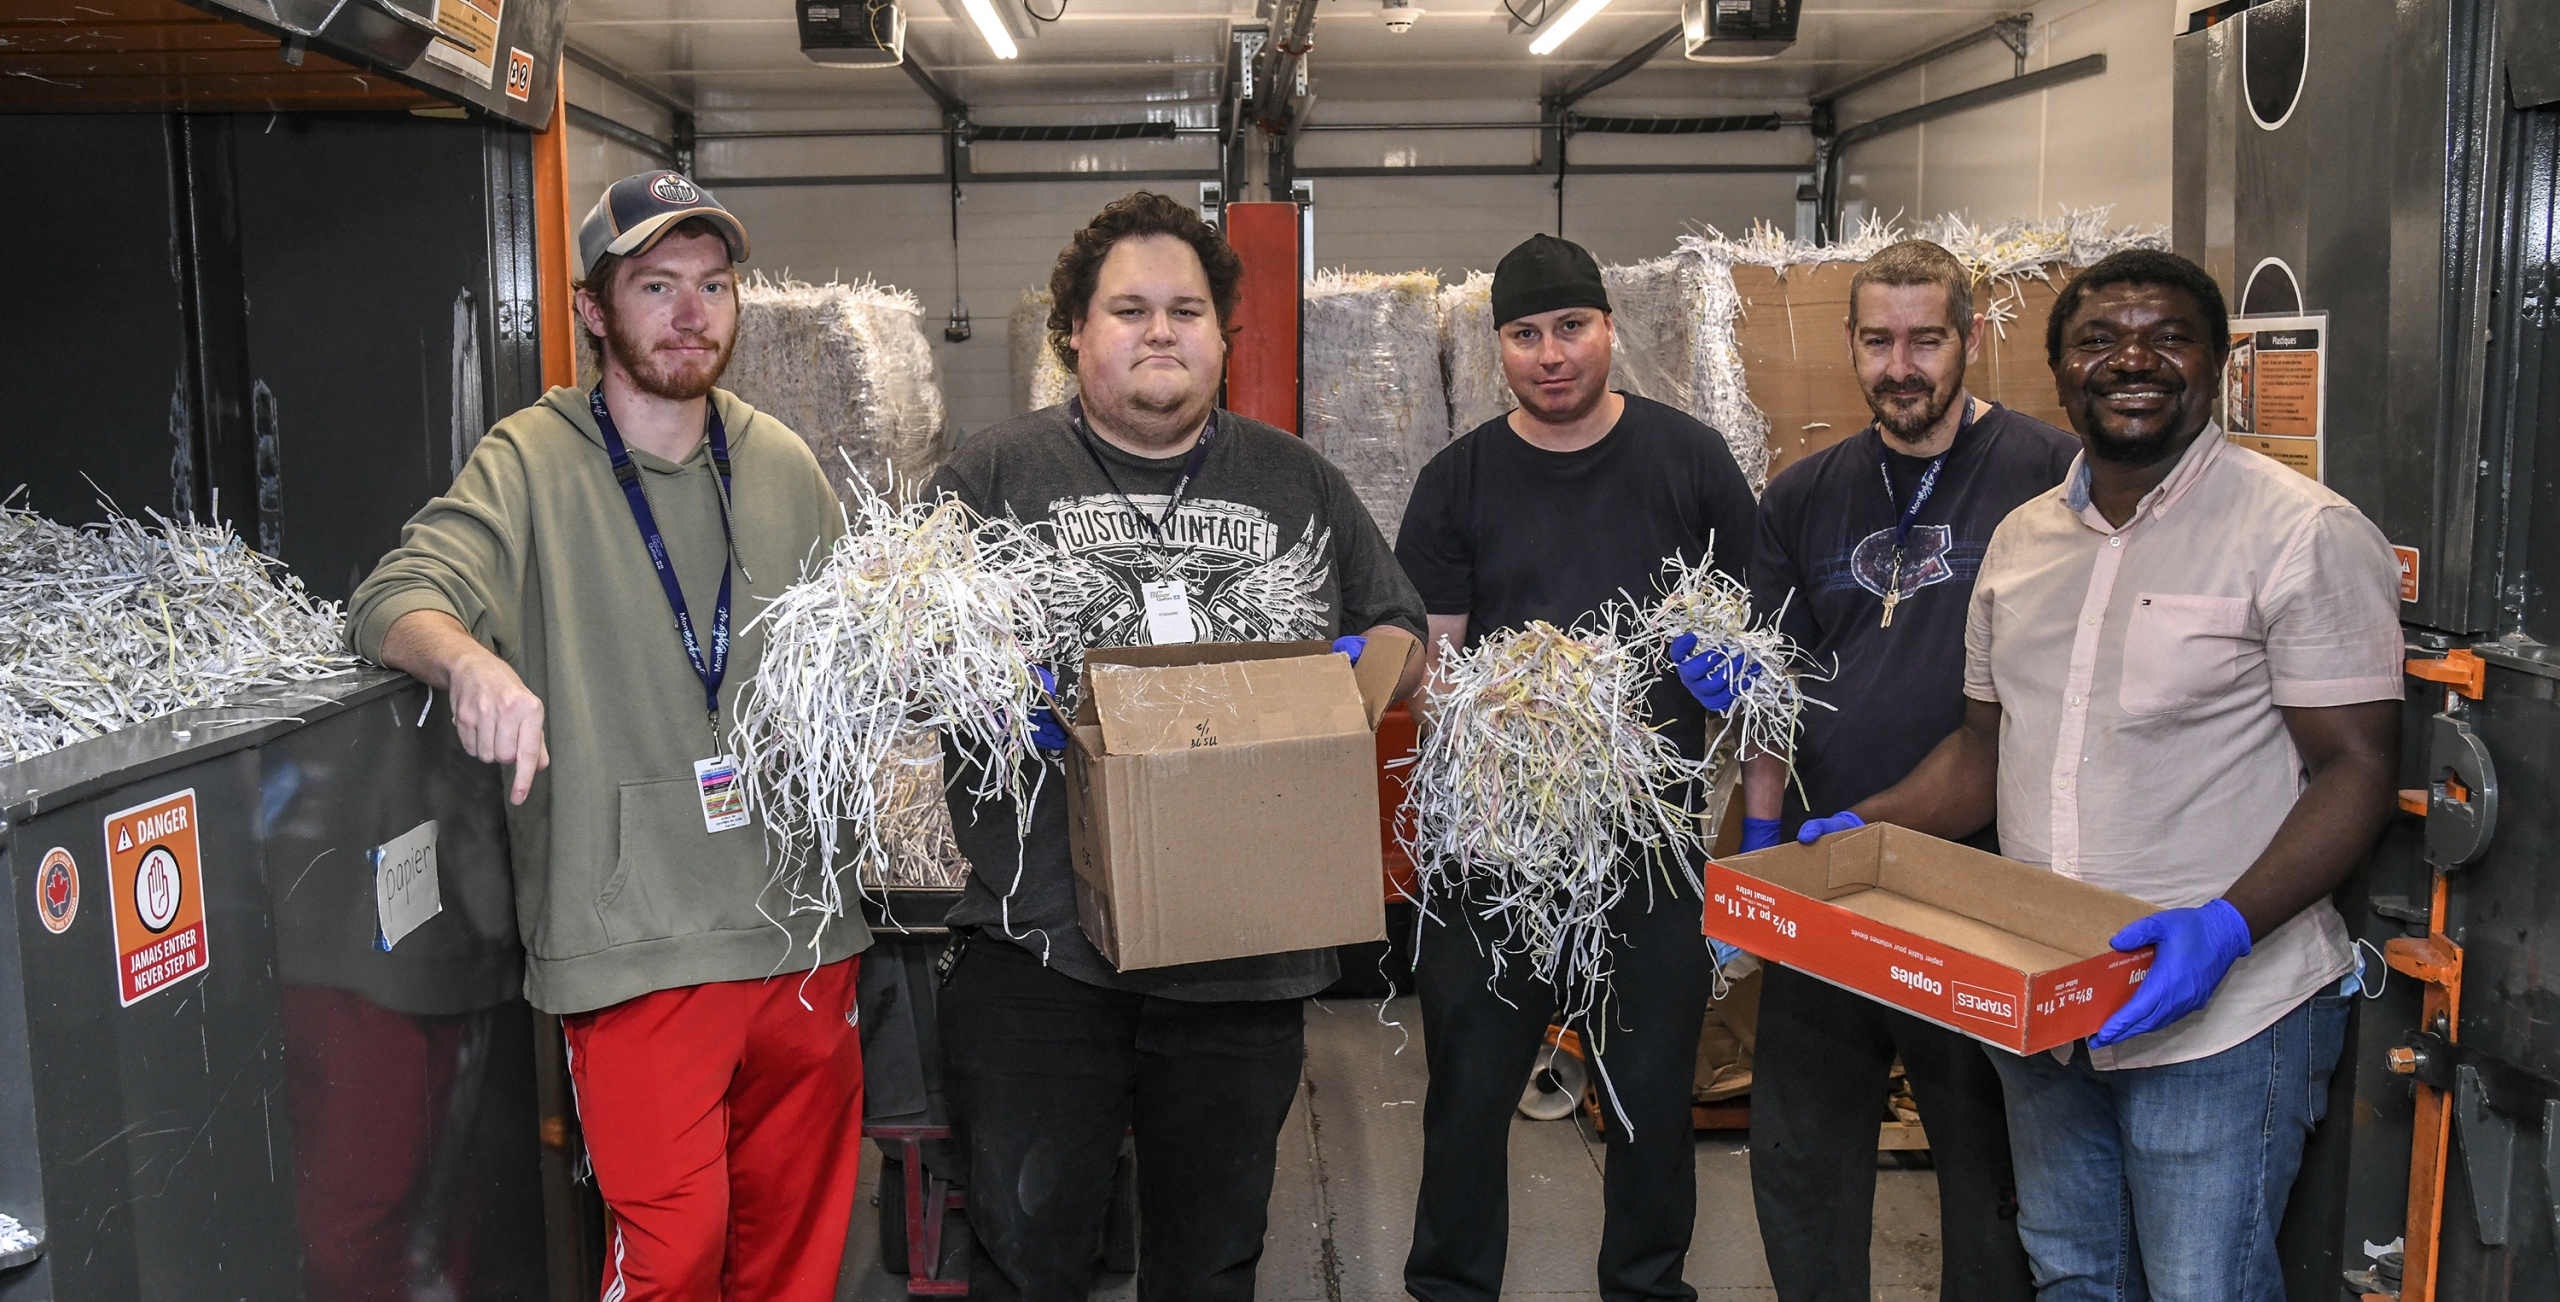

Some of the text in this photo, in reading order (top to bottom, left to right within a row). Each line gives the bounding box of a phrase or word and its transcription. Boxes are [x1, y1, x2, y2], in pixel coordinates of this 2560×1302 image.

[2272, 336, 2297, 346] Plastiques
[1063, 509, 1262, 558] CUSTOM VINTAGE
[137, 806, 188, 845] DANGER
[386, 845, 431, 922] papier
[1735, 884, 1776, 906] format lettre
[1714, 893, 1725, 904] po
[1728, 898, 1742, 917] 11
[1760, 910, 1771, 921] po
[130, 929, 197, 974] JAMAIS ENTRER
[1851, 929, 1943, 967] papier fiable pour volumes élevés
[134, 950, 196, 993] NEVER STEP IN
[1890, 965, 1942, 996] copies
[1957, 992, 2012, 1018] STAPLES
[2036, 1003, 2043, 1012] in
[2044, 999, 2055, 1016] 11
[2068, 993, 2075, 1002] in
